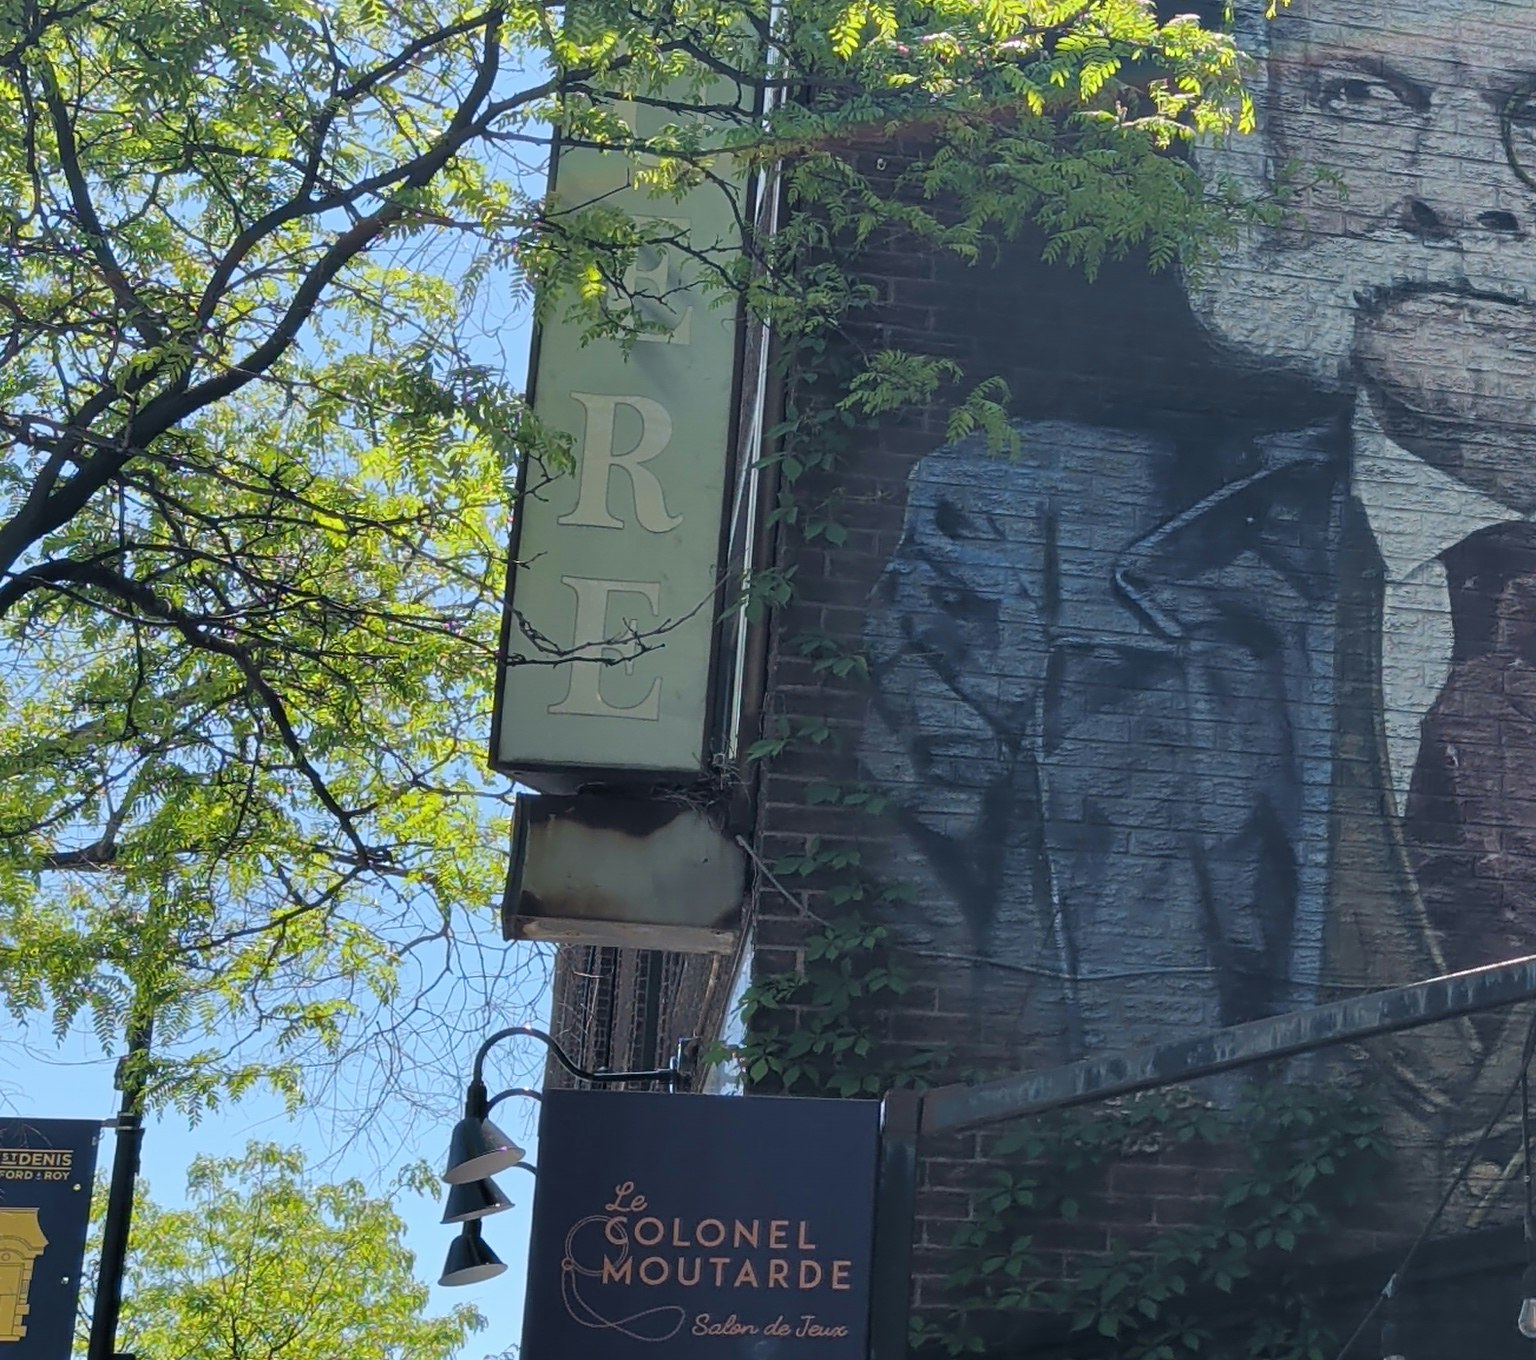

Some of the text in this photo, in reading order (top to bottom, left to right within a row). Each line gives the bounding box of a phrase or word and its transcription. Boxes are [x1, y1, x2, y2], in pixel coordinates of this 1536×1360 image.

[547, 80, 715, 721] ERE
[18, 1153, 73, 1167] DENIS
[44, 1171, 70, 1181] ROY
[605, 1181, 648, 1212] Le
[604, 1216, 817, 1250] COLONEL
[602, 1254, 853, 1290] MOUTARDE
[691, 1312, 849, 1338] Salon de Jeux
